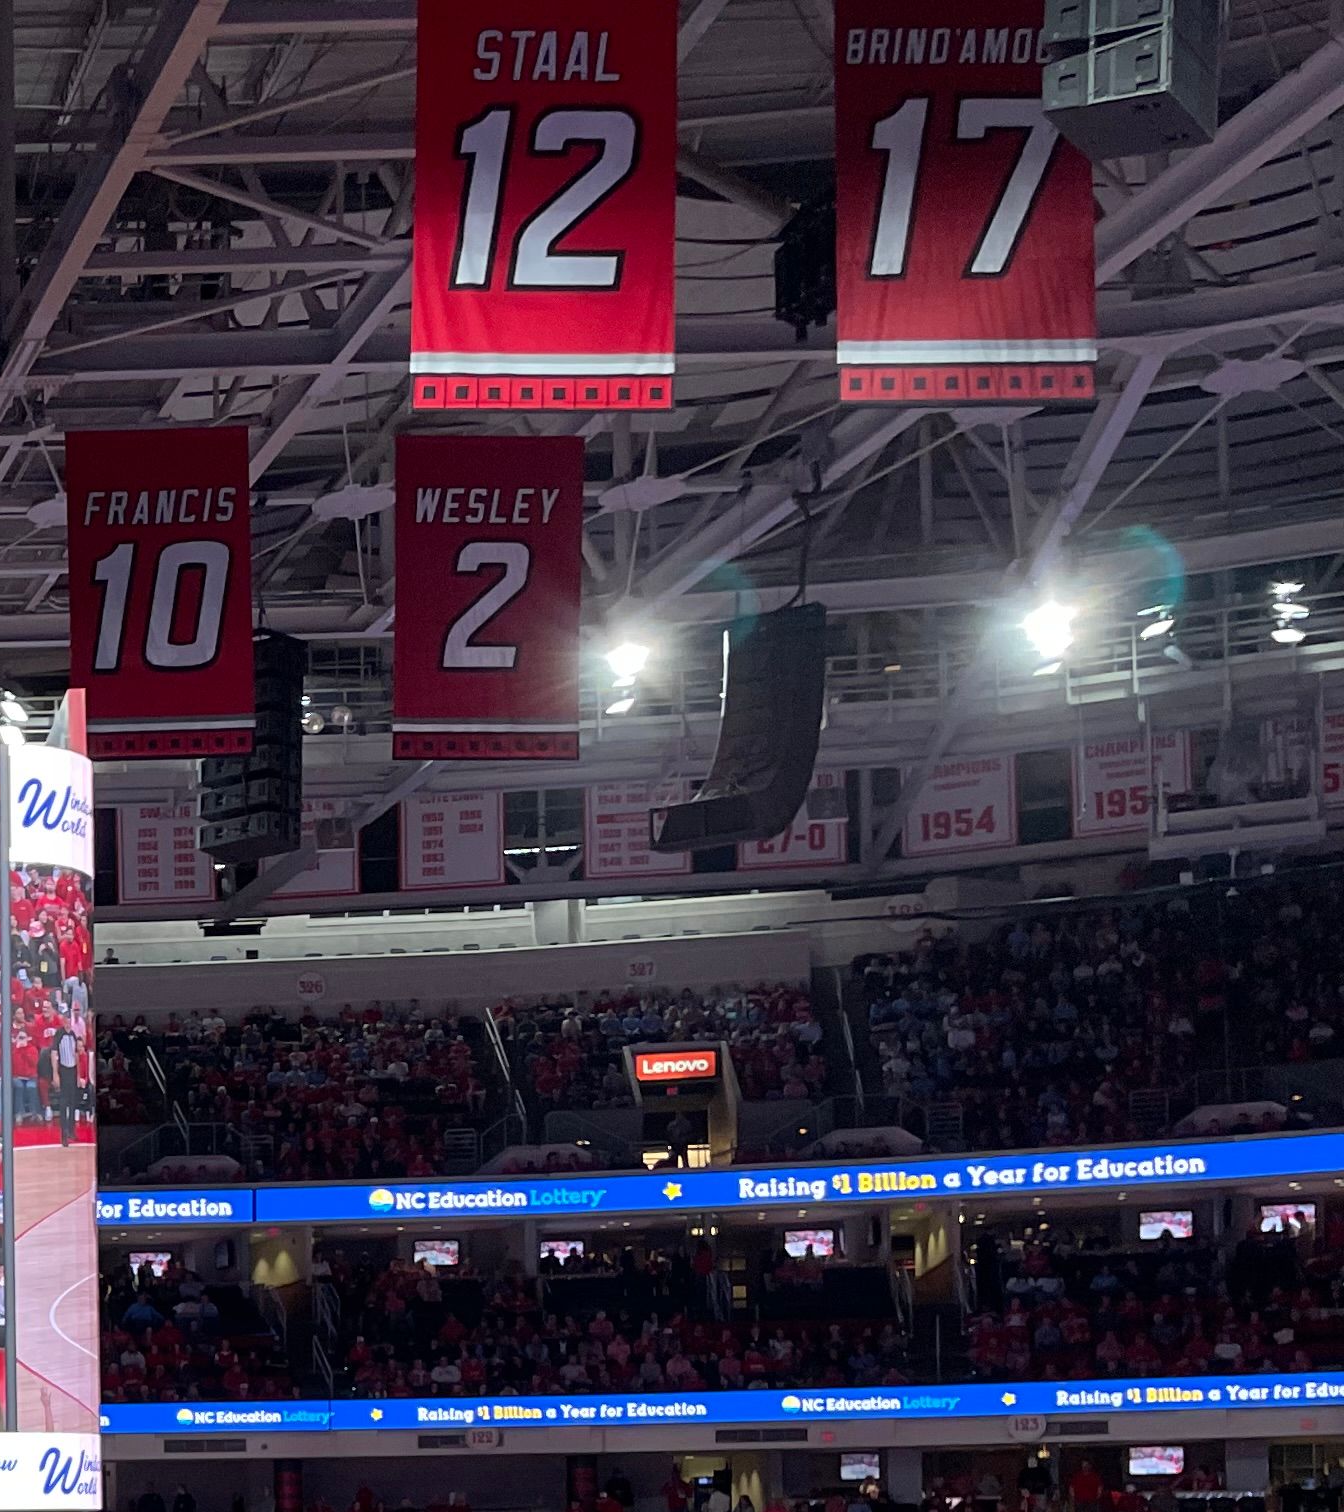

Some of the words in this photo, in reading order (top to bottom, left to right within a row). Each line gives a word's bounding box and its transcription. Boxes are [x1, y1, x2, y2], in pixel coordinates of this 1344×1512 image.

[473, 30, 621, 82] STAAL
[451, 108, 639, 288] 12
[868, 97, 1062, 277] 17
[84, 487, 237, 526] FRANCIS
[415, 487, 561, 524] WESLEY
[94, 540, 230, 669] 10
[443, 541, 530, 669] 2
[921, 805, 996, 841] 1954
[643, 1056, 708, 1074] Lenovo
[738, 1176, 825, 1200] Raising
[832, 1173, 852, 1194] $1
[857, 1171, 937, 1193] Billion
[943, 1173, 960, 1188] a
[966, 1164, 1026, 1187] Year
[1032, 1161, 1070, 1183] for
[1076, 1155, 1206, 1181] Education
[128, 1198, 233, 1218] Education
[397, 1193, 426, 1209] NC
[429, 1189, 527, 1208] Education
[531, 1188, 605, 1209] Lottery
[194, 1411, 214, 1424] NC
[216, 1410, 281, 1424] Education
